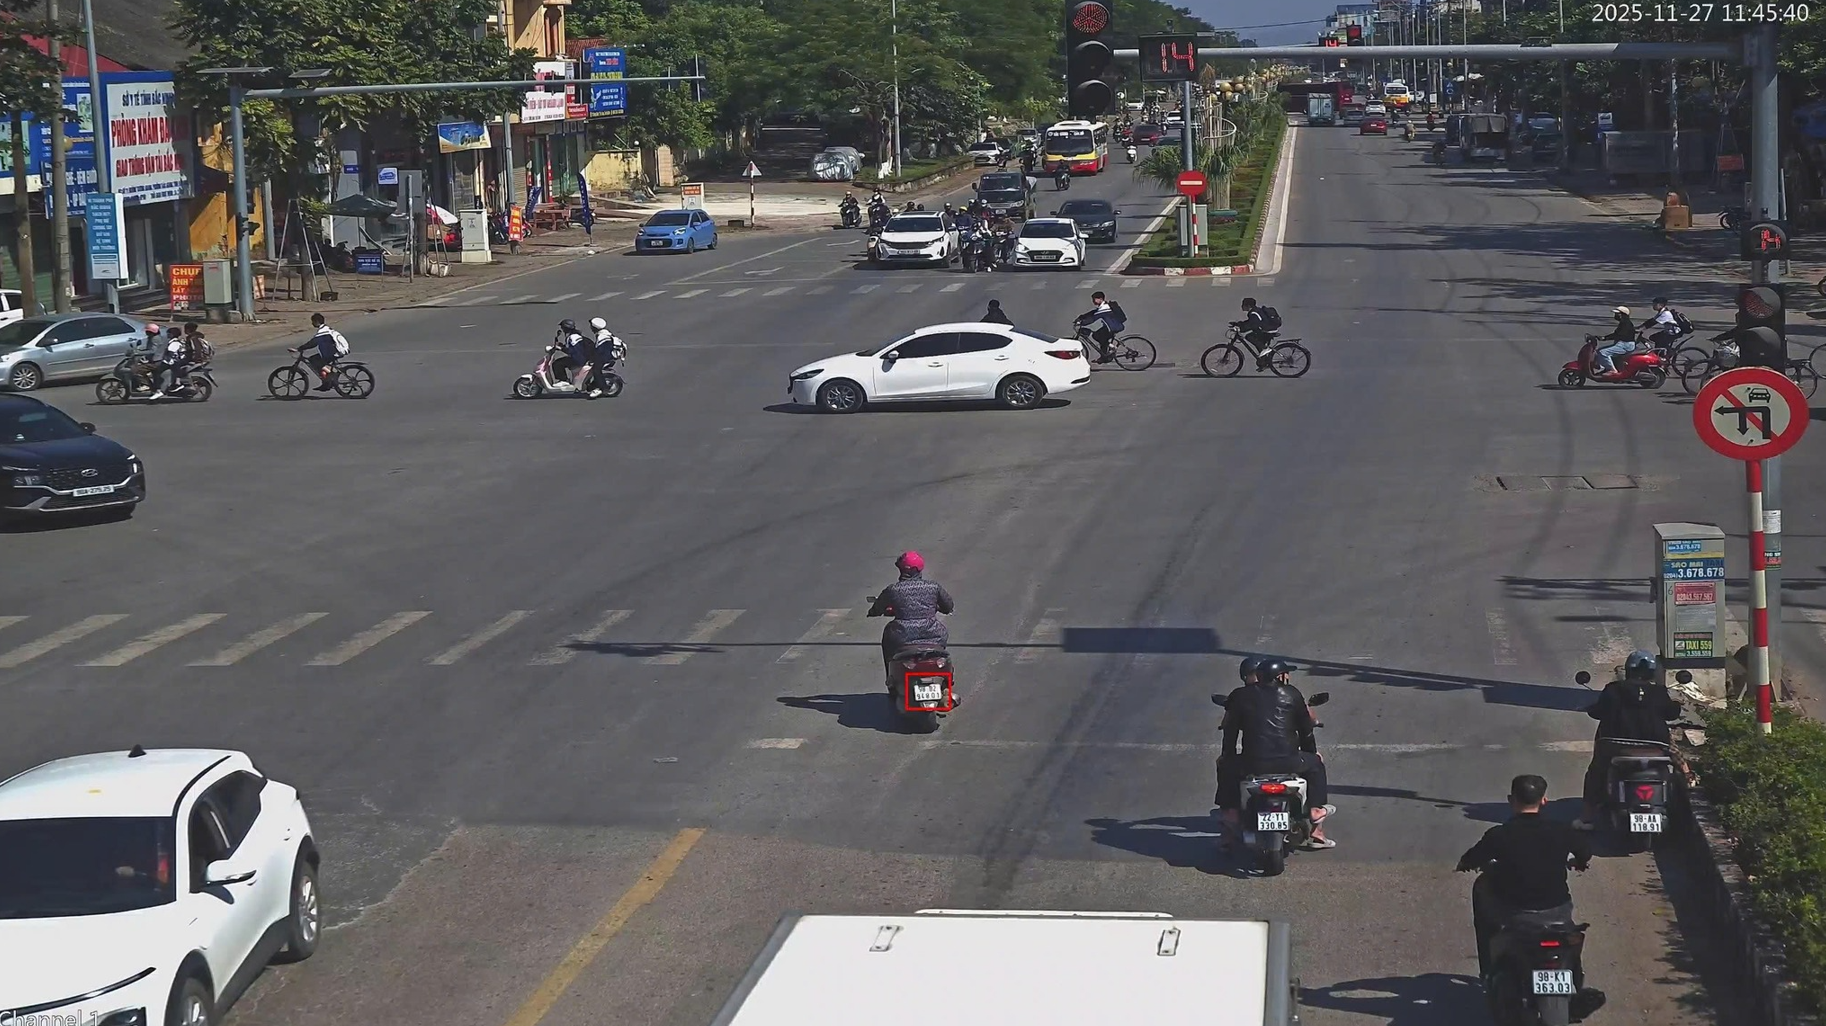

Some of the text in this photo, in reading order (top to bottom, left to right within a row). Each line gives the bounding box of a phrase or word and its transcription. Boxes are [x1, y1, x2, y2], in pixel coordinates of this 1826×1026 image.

[1161, 42, 1194, 72] 14
[1678, 567, 1724, 578] 3.678.678
[1685, 640, 1712, 650] TAXI 559
[1537, 971, 1566, 982] 98-K1
[1535, 982, 1570, 993] 363.03
